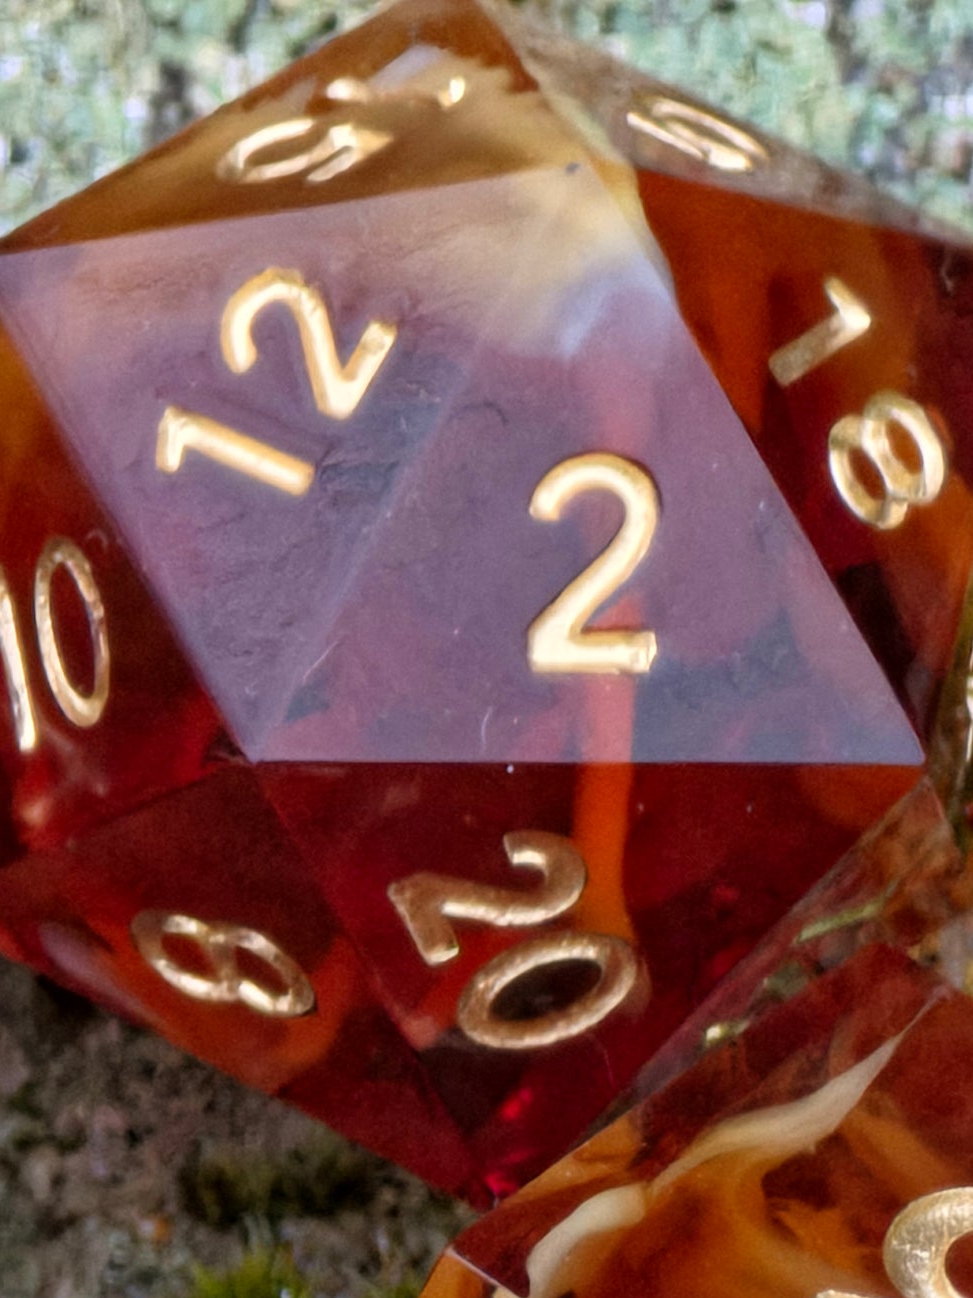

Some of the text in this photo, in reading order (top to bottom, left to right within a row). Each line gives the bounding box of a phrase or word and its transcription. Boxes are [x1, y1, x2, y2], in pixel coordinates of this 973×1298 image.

[153, 265, 399, 501] 12
[767, 274, 948, 531] 18
[527, 452, 662, 677] 2
[130, 909, 317, 1018] 8
[387, 829, 641, 1051] 20
